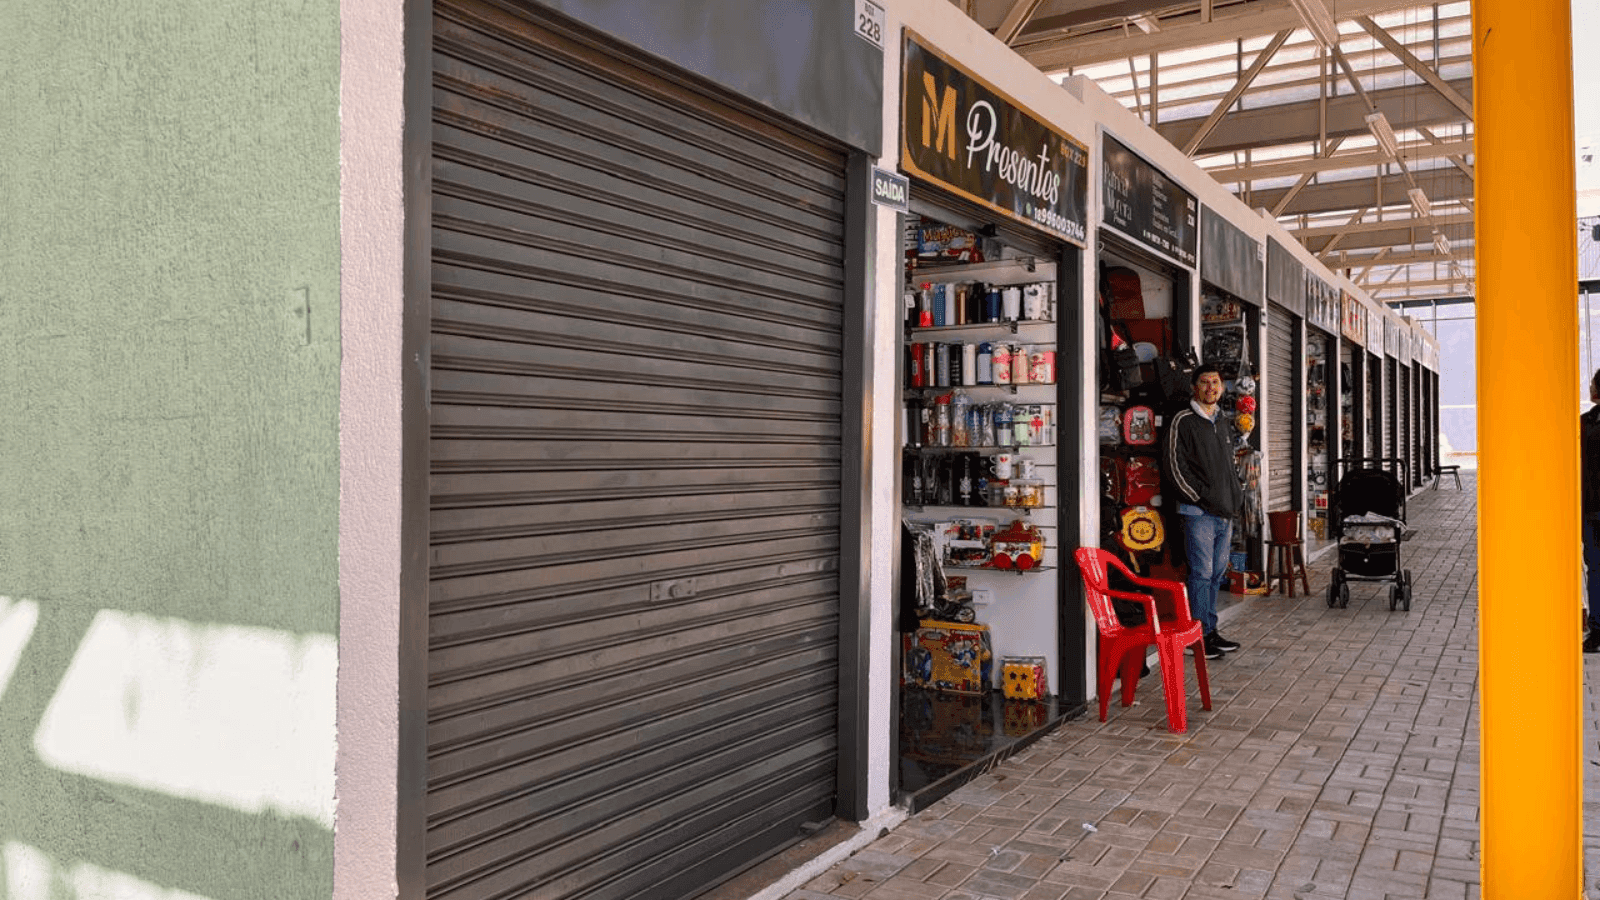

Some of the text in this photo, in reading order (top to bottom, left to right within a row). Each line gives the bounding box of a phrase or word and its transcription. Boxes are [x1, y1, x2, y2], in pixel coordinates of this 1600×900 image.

[859, 14, 881, 42] 228
[922, 71, 957, 160] M
[966, 100, 1060, 205] Presentes
[875, 178, 905, 203] SAÍDA
